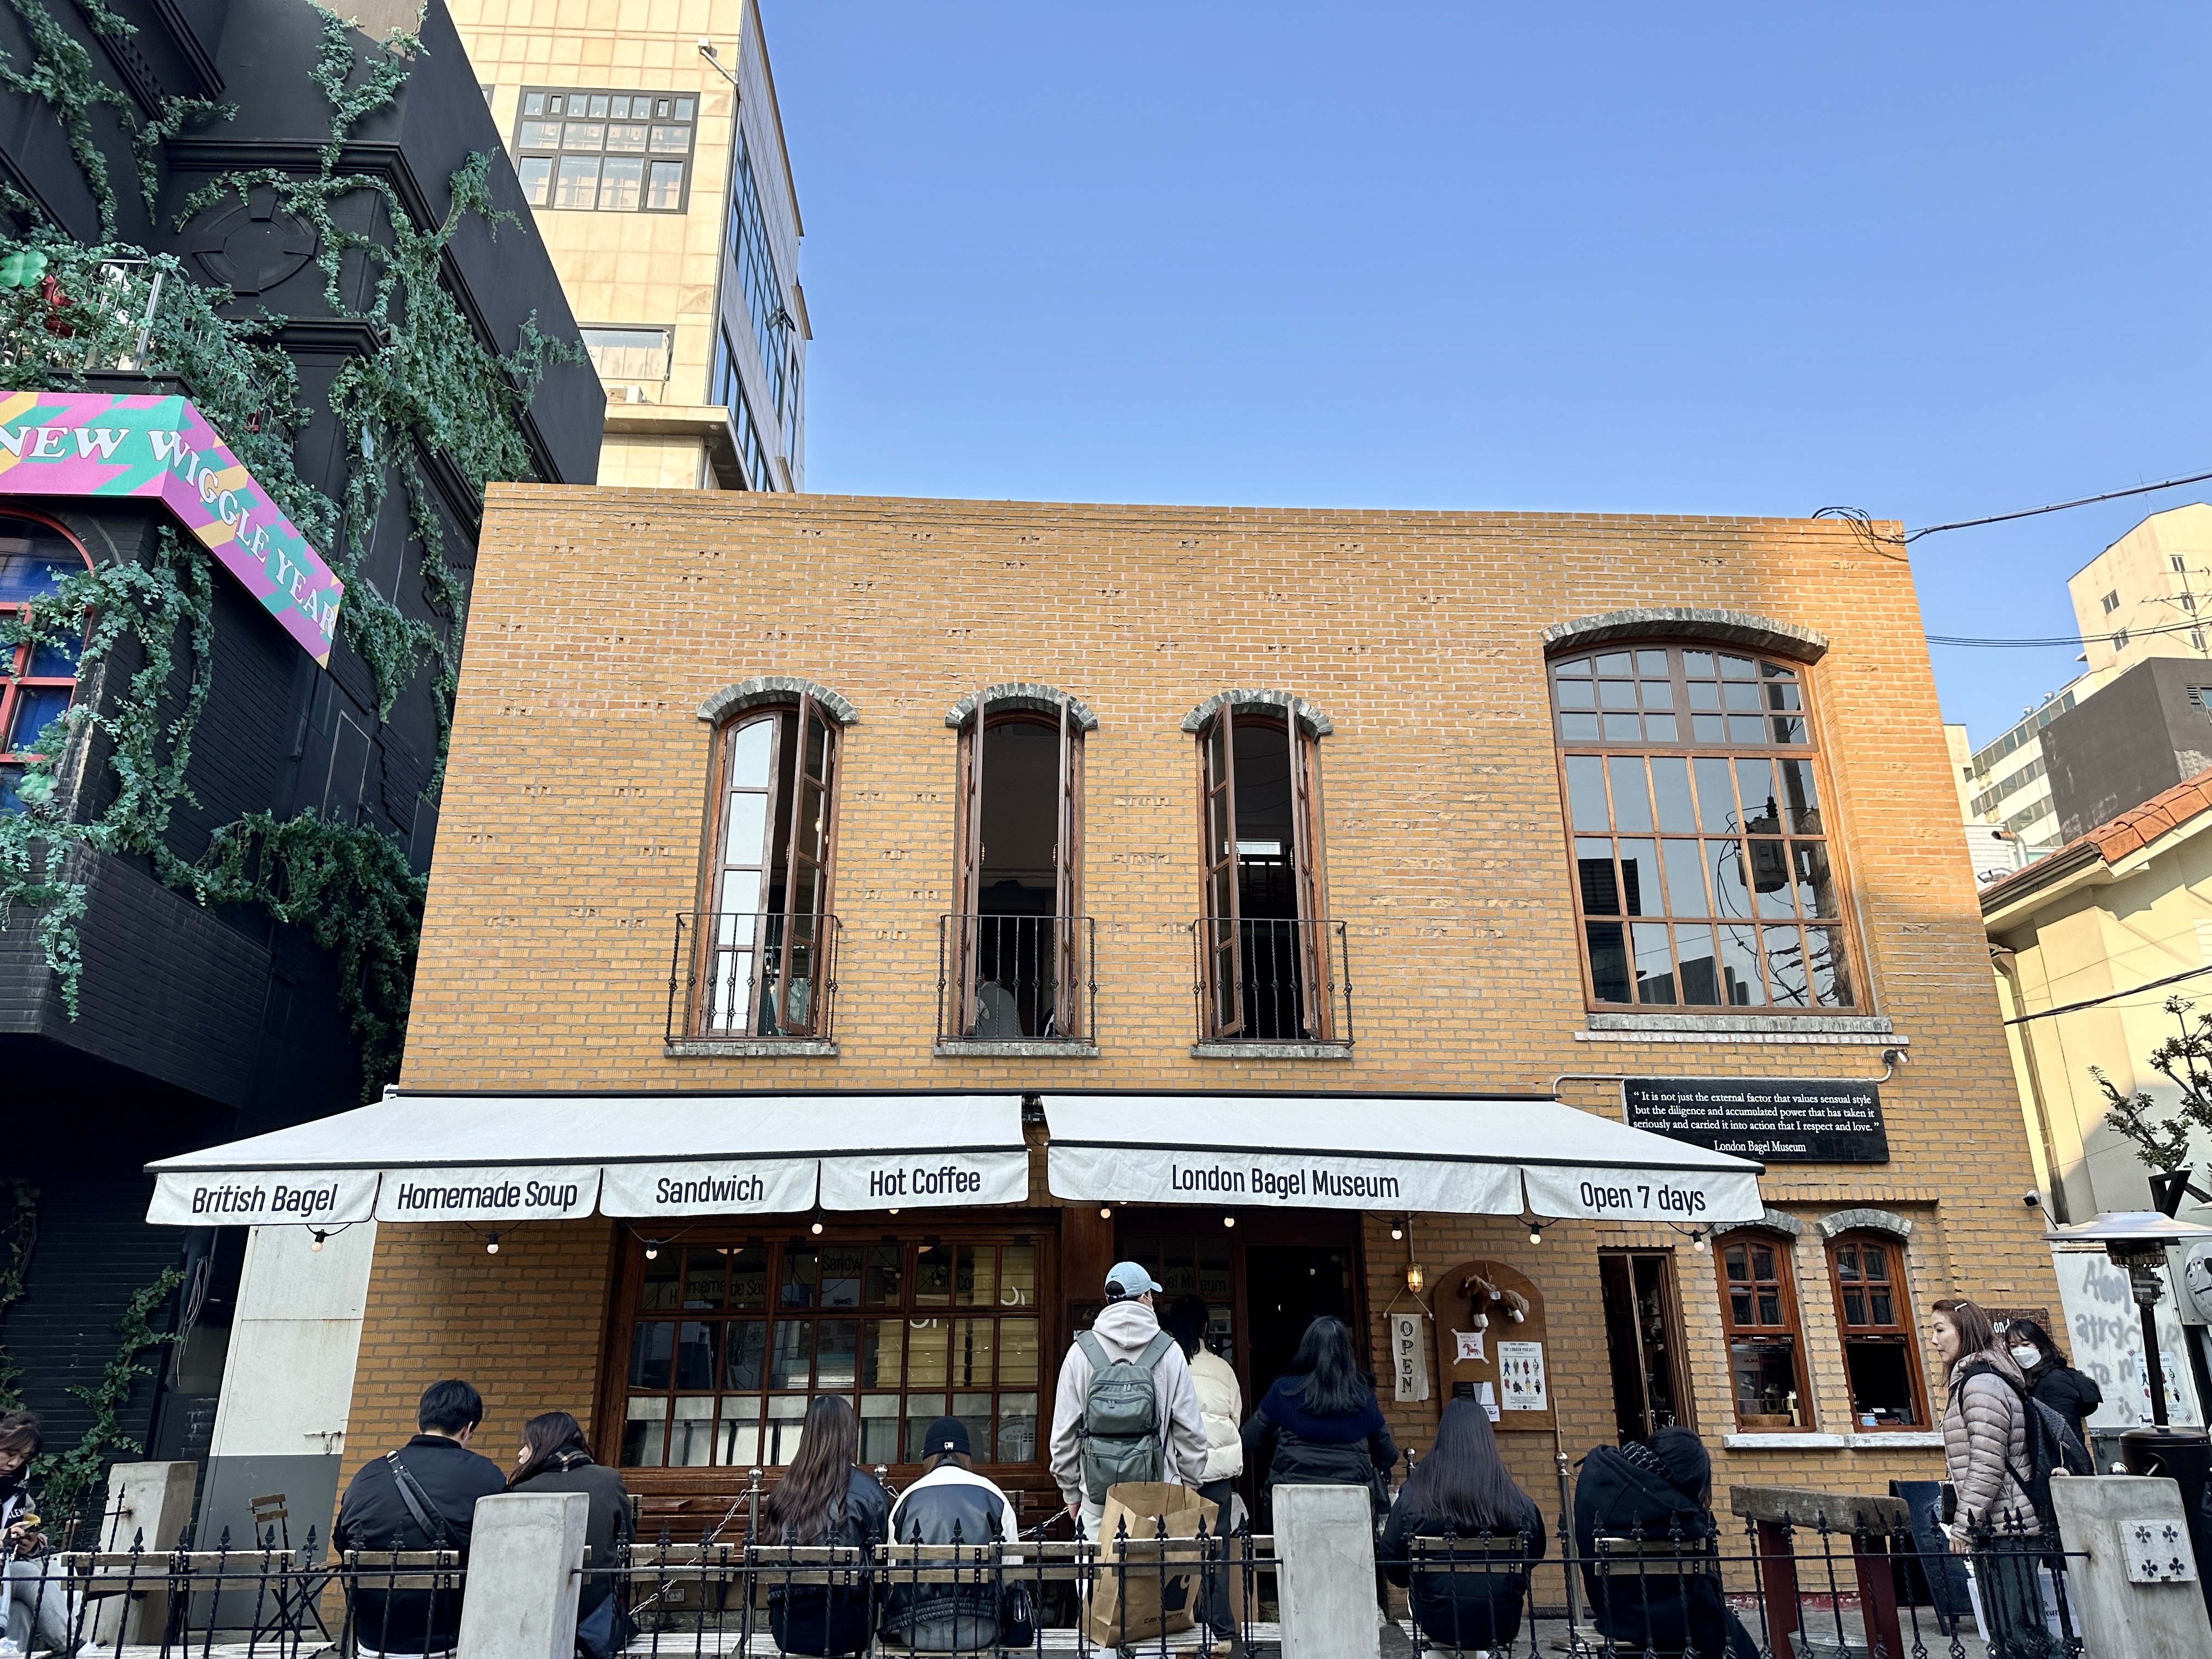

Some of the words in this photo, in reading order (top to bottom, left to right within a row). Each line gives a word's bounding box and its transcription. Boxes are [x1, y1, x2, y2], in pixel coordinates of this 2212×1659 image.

[0, 425, 130, 459] NEW
[147, 430, 270, 564] WIGGLE
[274, 547, 336, 641] YEAR
[1634, 1105, 1650, 1115] but
[1652, 1105, 1666, 1115] the
[1668, 1105, 1706, 1118] diligence
[1707, 1106, 1723, 1115] and
[1725, 1106, 1778, 1116] accumulated
[1780, 1109, 1807, 1119] power
[1808, 1107, 1825, 1117] that
[1826, 1107, 1842, 1117] has
[1843, 1108, 1866, 1118] taken
[1867, 1108, 1875, 1118] it
[1641, 1091, 1650, 1101] It
[1651, 1091, 1658, 1101] is
[1661, 1093, 1676, 1102] not
[1677, 1092, 1692, 1104] just
[1695, 1092, 1709, 1102] the
[1711, 1092, 1745, 1102] external
[1747, 1093, 1771, 1103] factor
[1774, 1093, 1791, 1103] that
[1792, 1093, 1818, 1103] values
[1820, 1094, 1850, 1104] sensual
[1853, 1094, 1872, 1107] style
[1633, 1119, 1671, 1131] seriously
[1673, 1119, 1689, 1129] and
[1691, 1119, 1720, 1129] carried
[1722, 1120, 1729, 1130] it
[1730, 1120, 1747, 1130] into
[1750, 1120, 1776, 1130] action
[1778, 1121, 1795, 1130] that
[1796, 1121, 1801, 1130] I
[1803, 1123, 1833, 1133] respect
[1835, 1121, 1852, 1131] and
[1713, 1140, 1746, 1152] London
[1747, 1140, 1771, 1155] Bagel
[1771, 1141, 1807, 1152] Museum
[397, 1181, 521, 1210] Homemade
[524, 1181, 578, 1212] Soup
[656, 1174, 763, 1204] Sandwich
[870, 1168, 906, 1197] Hot
[912, 1166, 981, 1193] Coffee
[1172, 1164, 1245, 1192] London
[1251, 1167, 1306, 1200] Bagel
[1312, 1170, 1400, 1198] Museum
[192, 1185, 266, 1214] British
[271, 1183, 338, 1217] Bagel
[1580, 1182, 1633, 1213] Open
[1637, 1185, 1650, 1209] 7
[1657, 1184, 1706, 1216] days
[1400, 1321, 1414, 1393] OPEN
